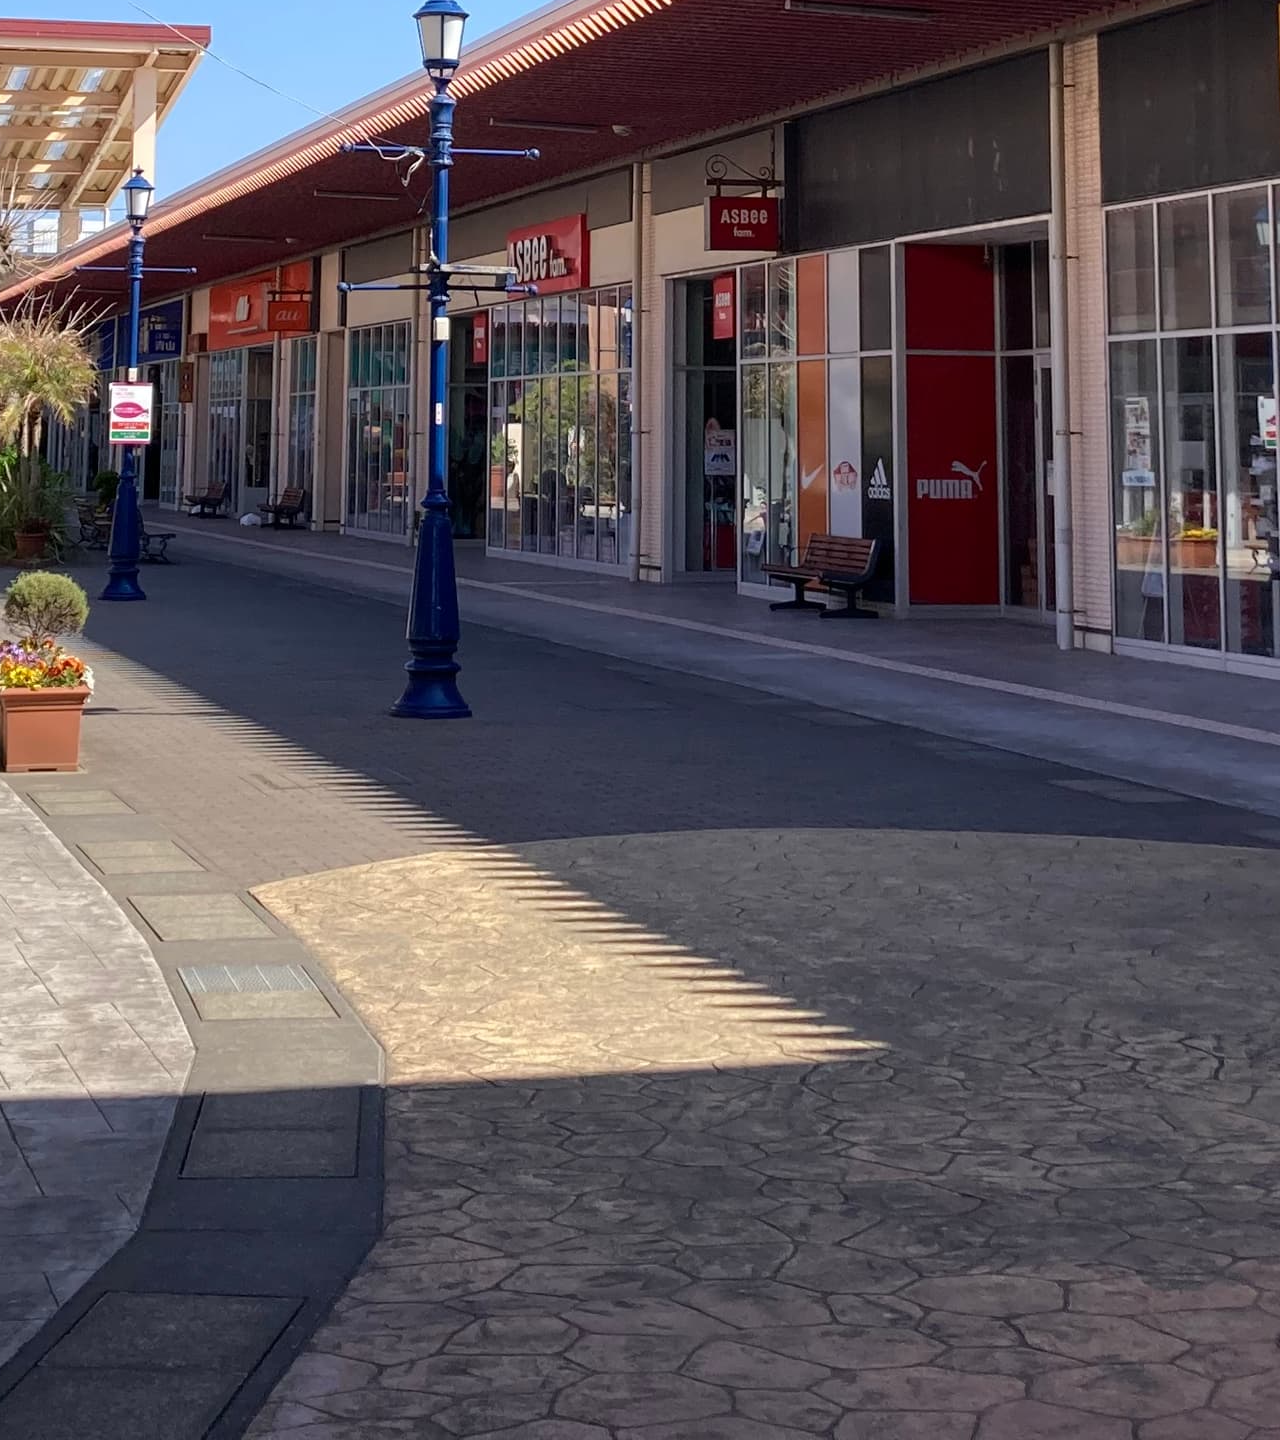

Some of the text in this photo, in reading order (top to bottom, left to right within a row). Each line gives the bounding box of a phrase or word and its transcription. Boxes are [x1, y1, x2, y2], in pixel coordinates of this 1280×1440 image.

[720, 209, 768, 224] ASBee
[276, 310, 300, 320] au
[916, 479, 973, 499] PUMA
